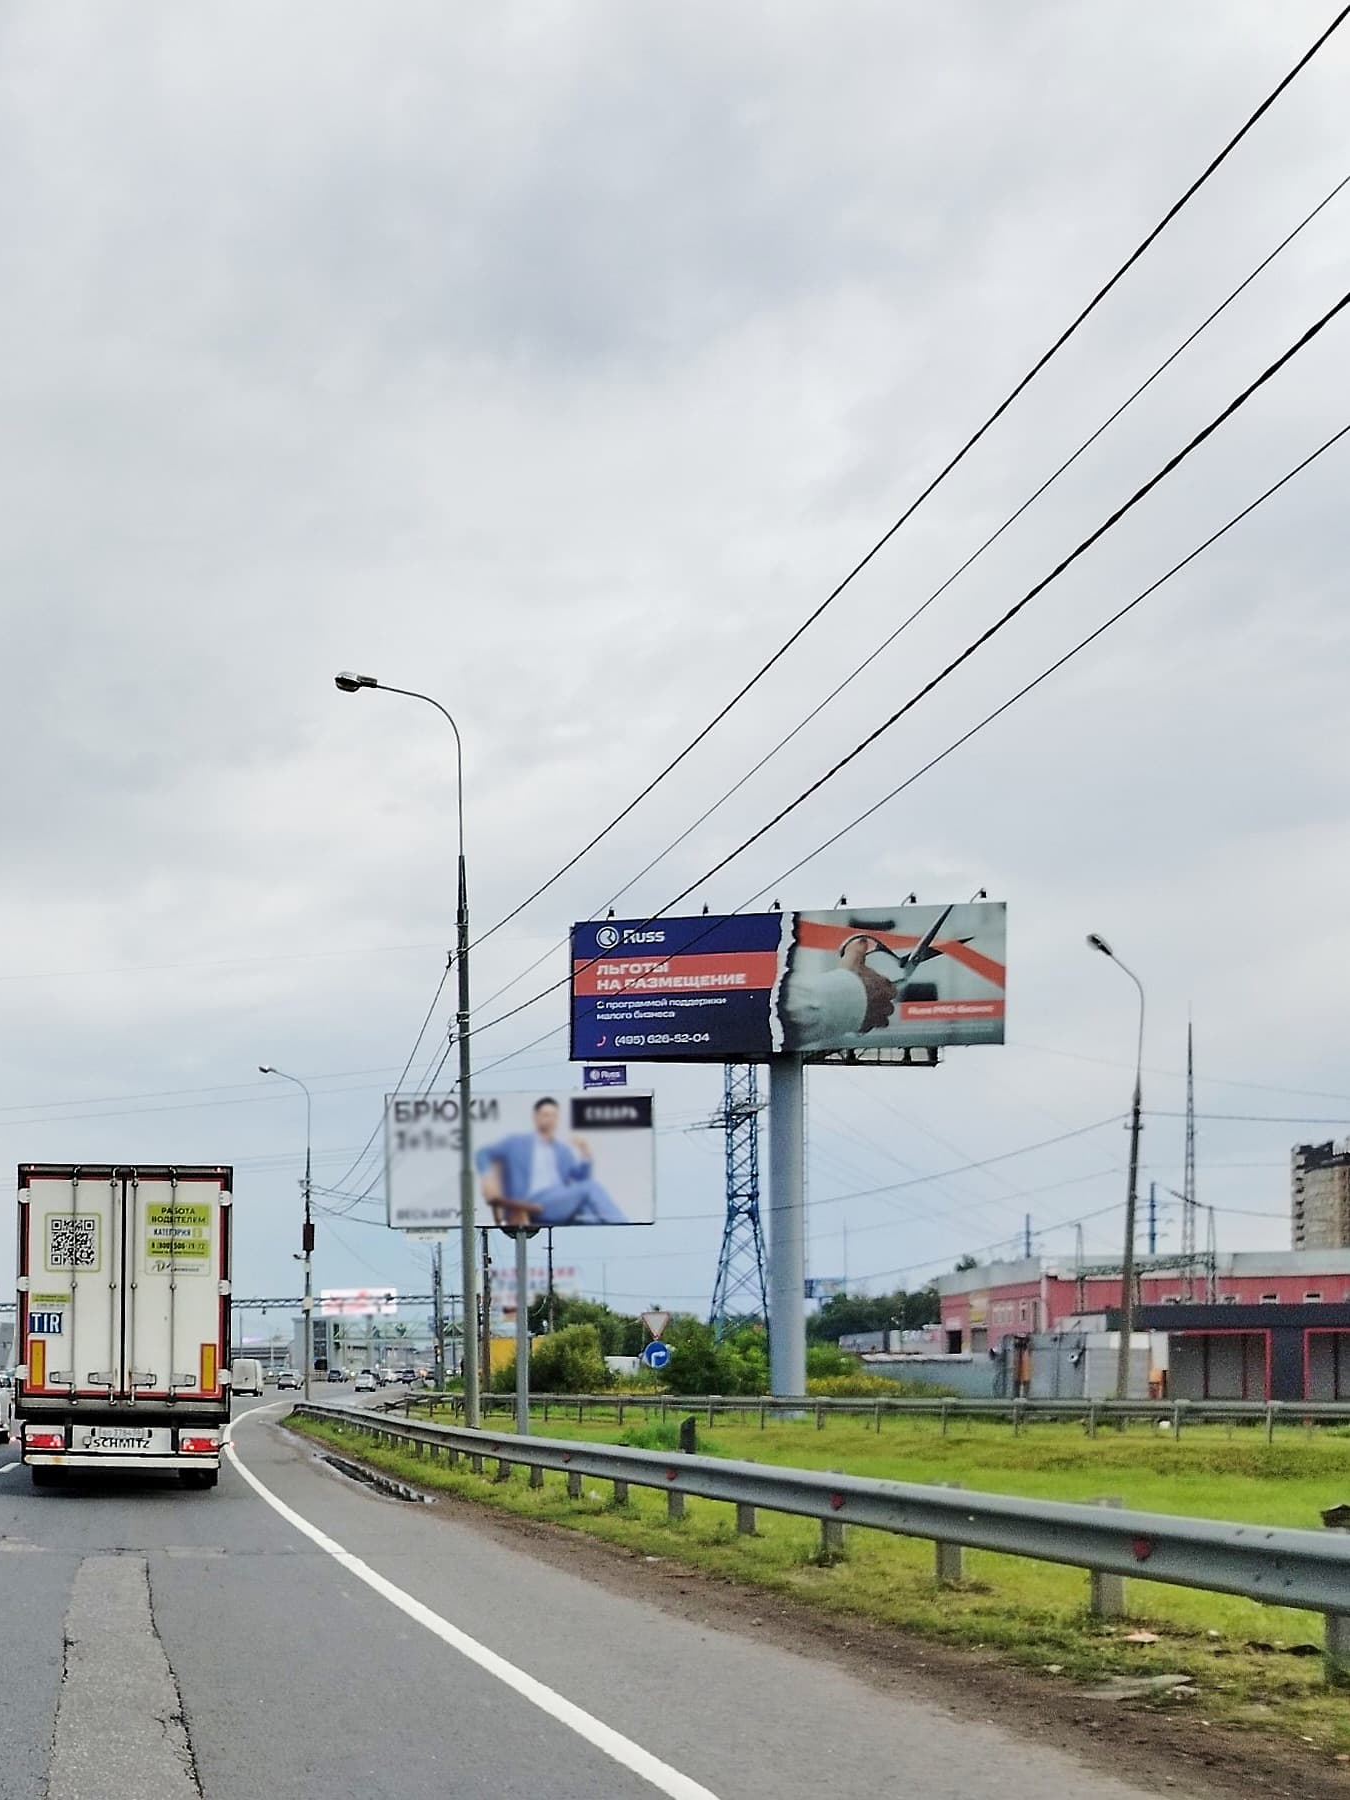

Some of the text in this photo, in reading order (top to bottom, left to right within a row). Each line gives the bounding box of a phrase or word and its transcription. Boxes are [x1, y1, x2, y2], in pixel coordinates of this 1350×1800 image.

[623, 930, 666, 943] Russ
[596, 962, 669, 975] ЛЬГОТЫ
[596, 973, 747, 991] НА РАЗМЕЩЕНИЕ
[596, 1000, 605, 1009] С
[605, 997, 668, 1010] программой
[596, 1009, 675, 1020] малого бизнеса
[614, 1035, 645, 1047] (495)
[31, 1314, 61, 1333] TIR
[93, 1436, 150, 1448] SCHMITZ
